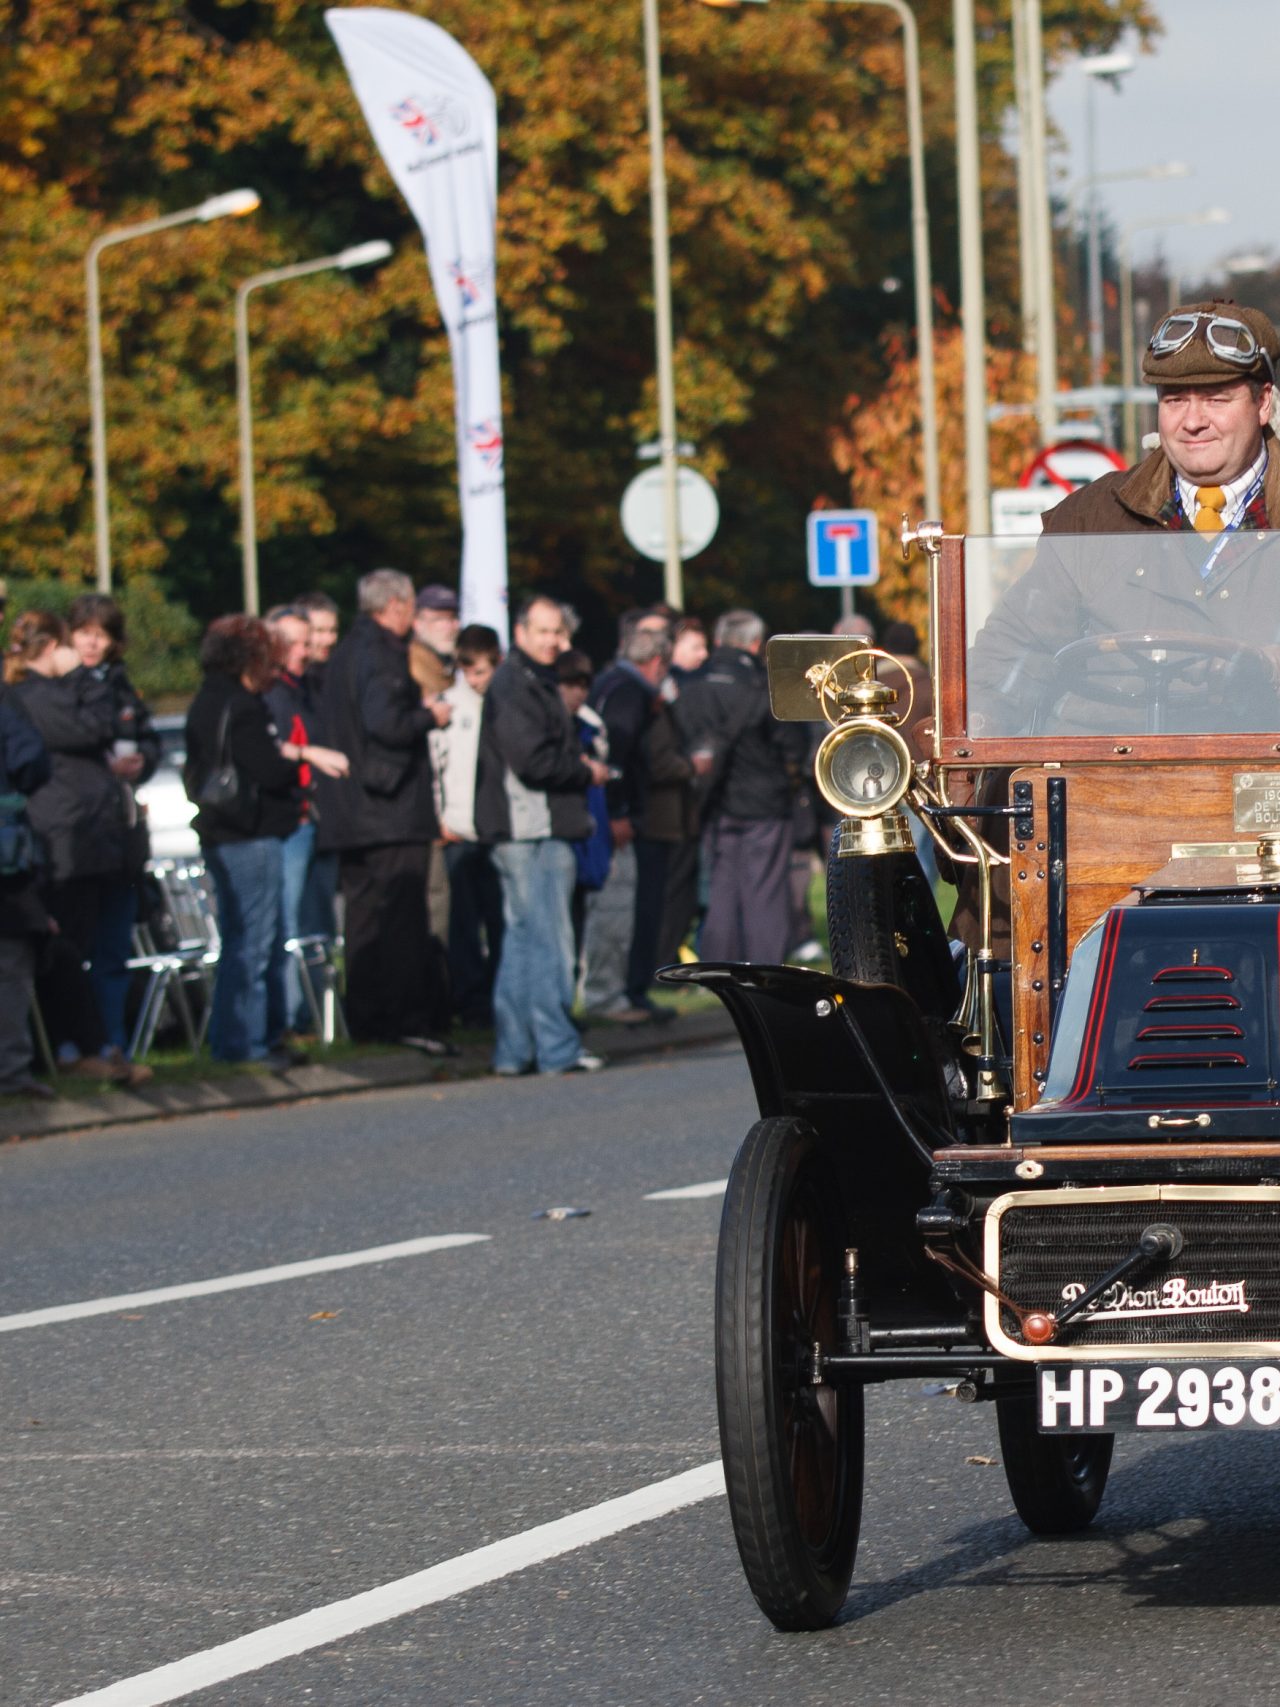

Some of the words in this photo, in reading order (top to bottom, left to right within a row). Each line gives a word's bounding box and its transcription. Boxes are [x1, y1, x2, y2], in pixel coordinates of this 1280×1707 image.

[1254, 801, 1270, 812] DE
[1104, 1281, 1159, 1309] Dion
[1162, 1278, 1246, 1309] Bouton
[1041, 1368, 1125, 1427] HP
